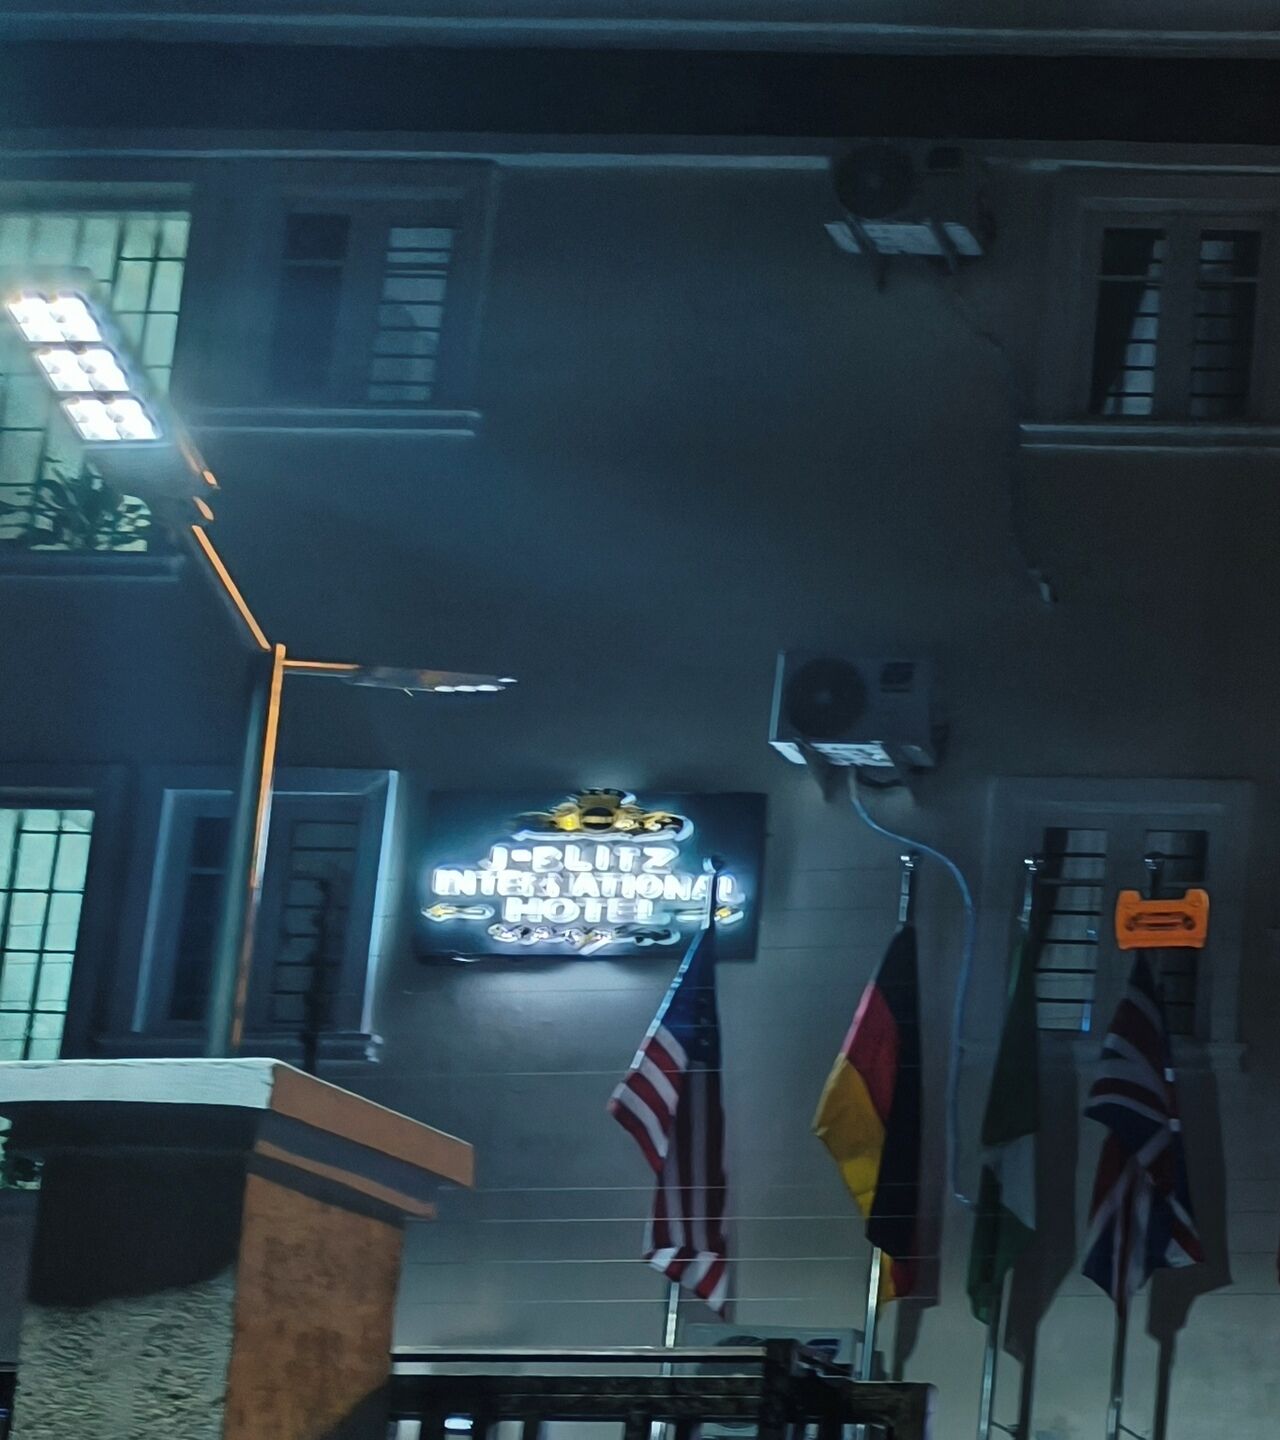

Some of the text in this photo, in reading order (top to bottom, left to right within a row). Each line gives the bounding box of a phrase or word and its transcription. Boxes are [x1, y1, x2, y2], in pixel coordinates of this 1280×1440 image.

[480, 844, 678, 874] J-BLITZ
[433, 868, 744, 902] INTERNATIONAL
[500, 897, 666, 924] HOTEL
